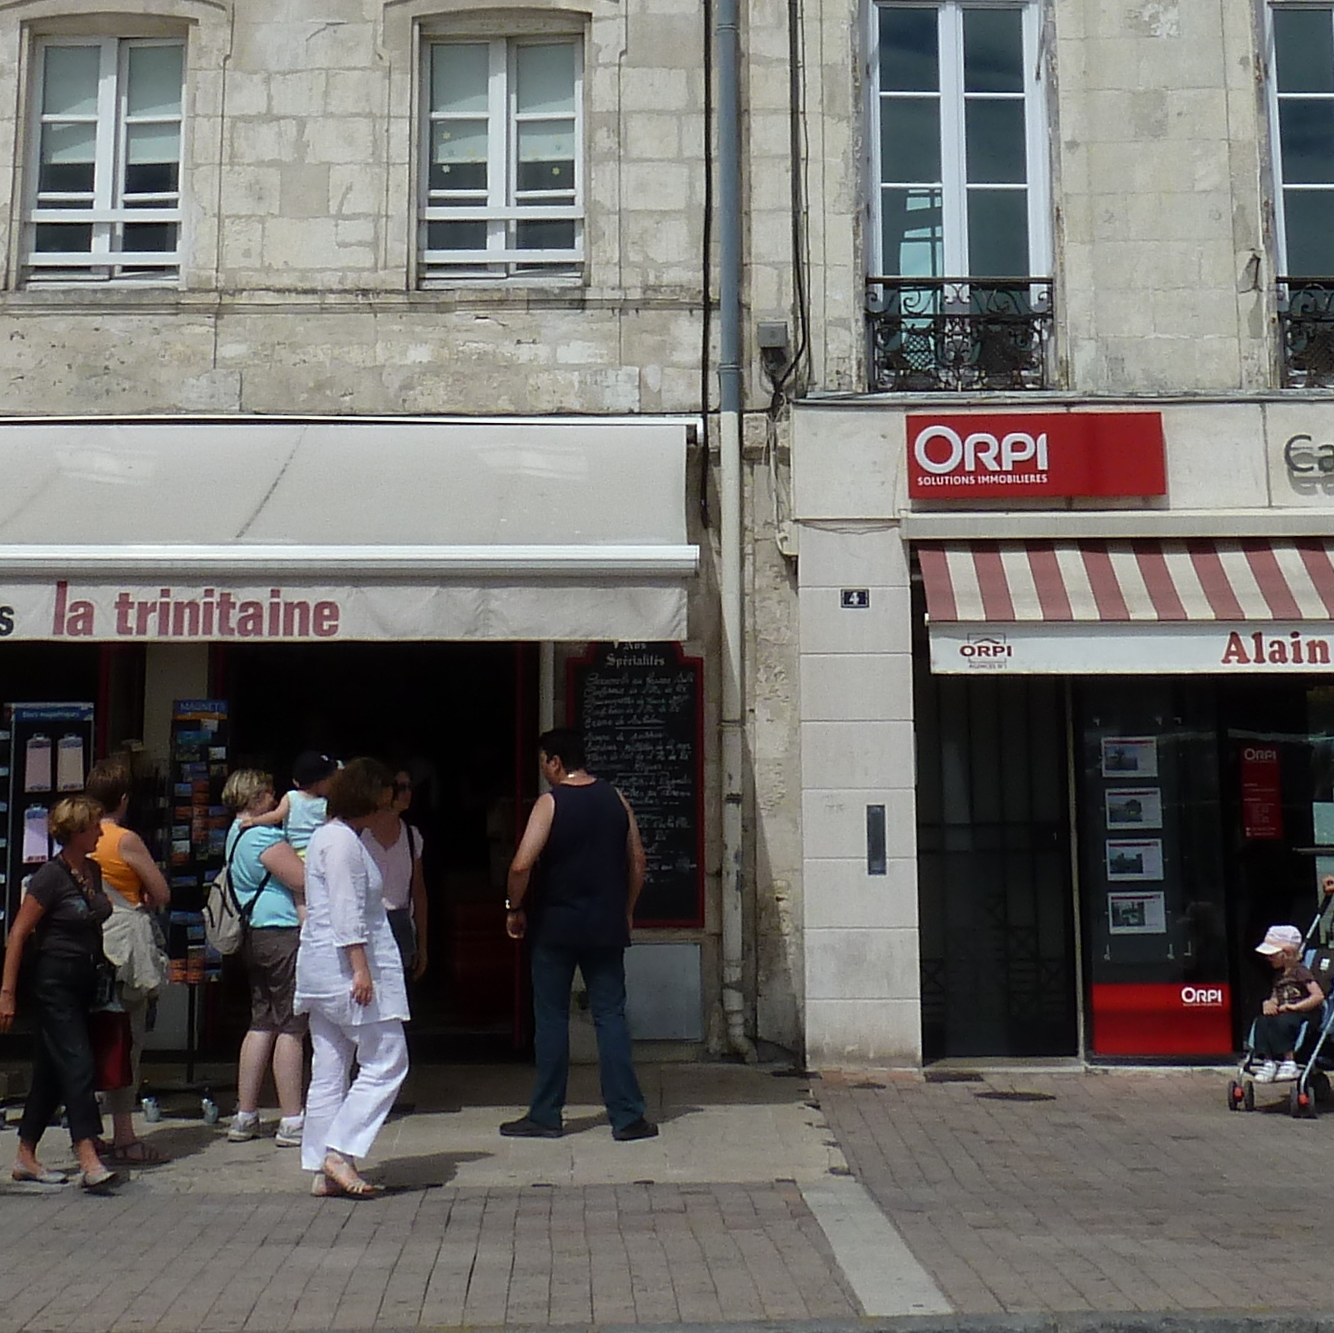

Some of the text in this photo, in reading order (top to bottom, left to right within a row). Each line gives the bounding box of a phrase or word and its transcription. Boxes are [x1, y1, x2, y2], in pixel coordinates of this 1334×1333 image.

[914, 425, 1048, 474] ORPI
[917, 474, 1048, 486] SOLUTIONS IMMOBILIERES
[849, 592, 859, 605] 4
[53, 581, 94, 636] la
[115, 588, 340, 637] trinitaine
[959, 645, 1012, 657] ORPI
[1221, 631, 1330, 664] Alain
[606, 653, 665, 669] Spécialités
[1244, 748, 1276, 761] ORPI
[1181, 987, 1222, 1003] ORPI
